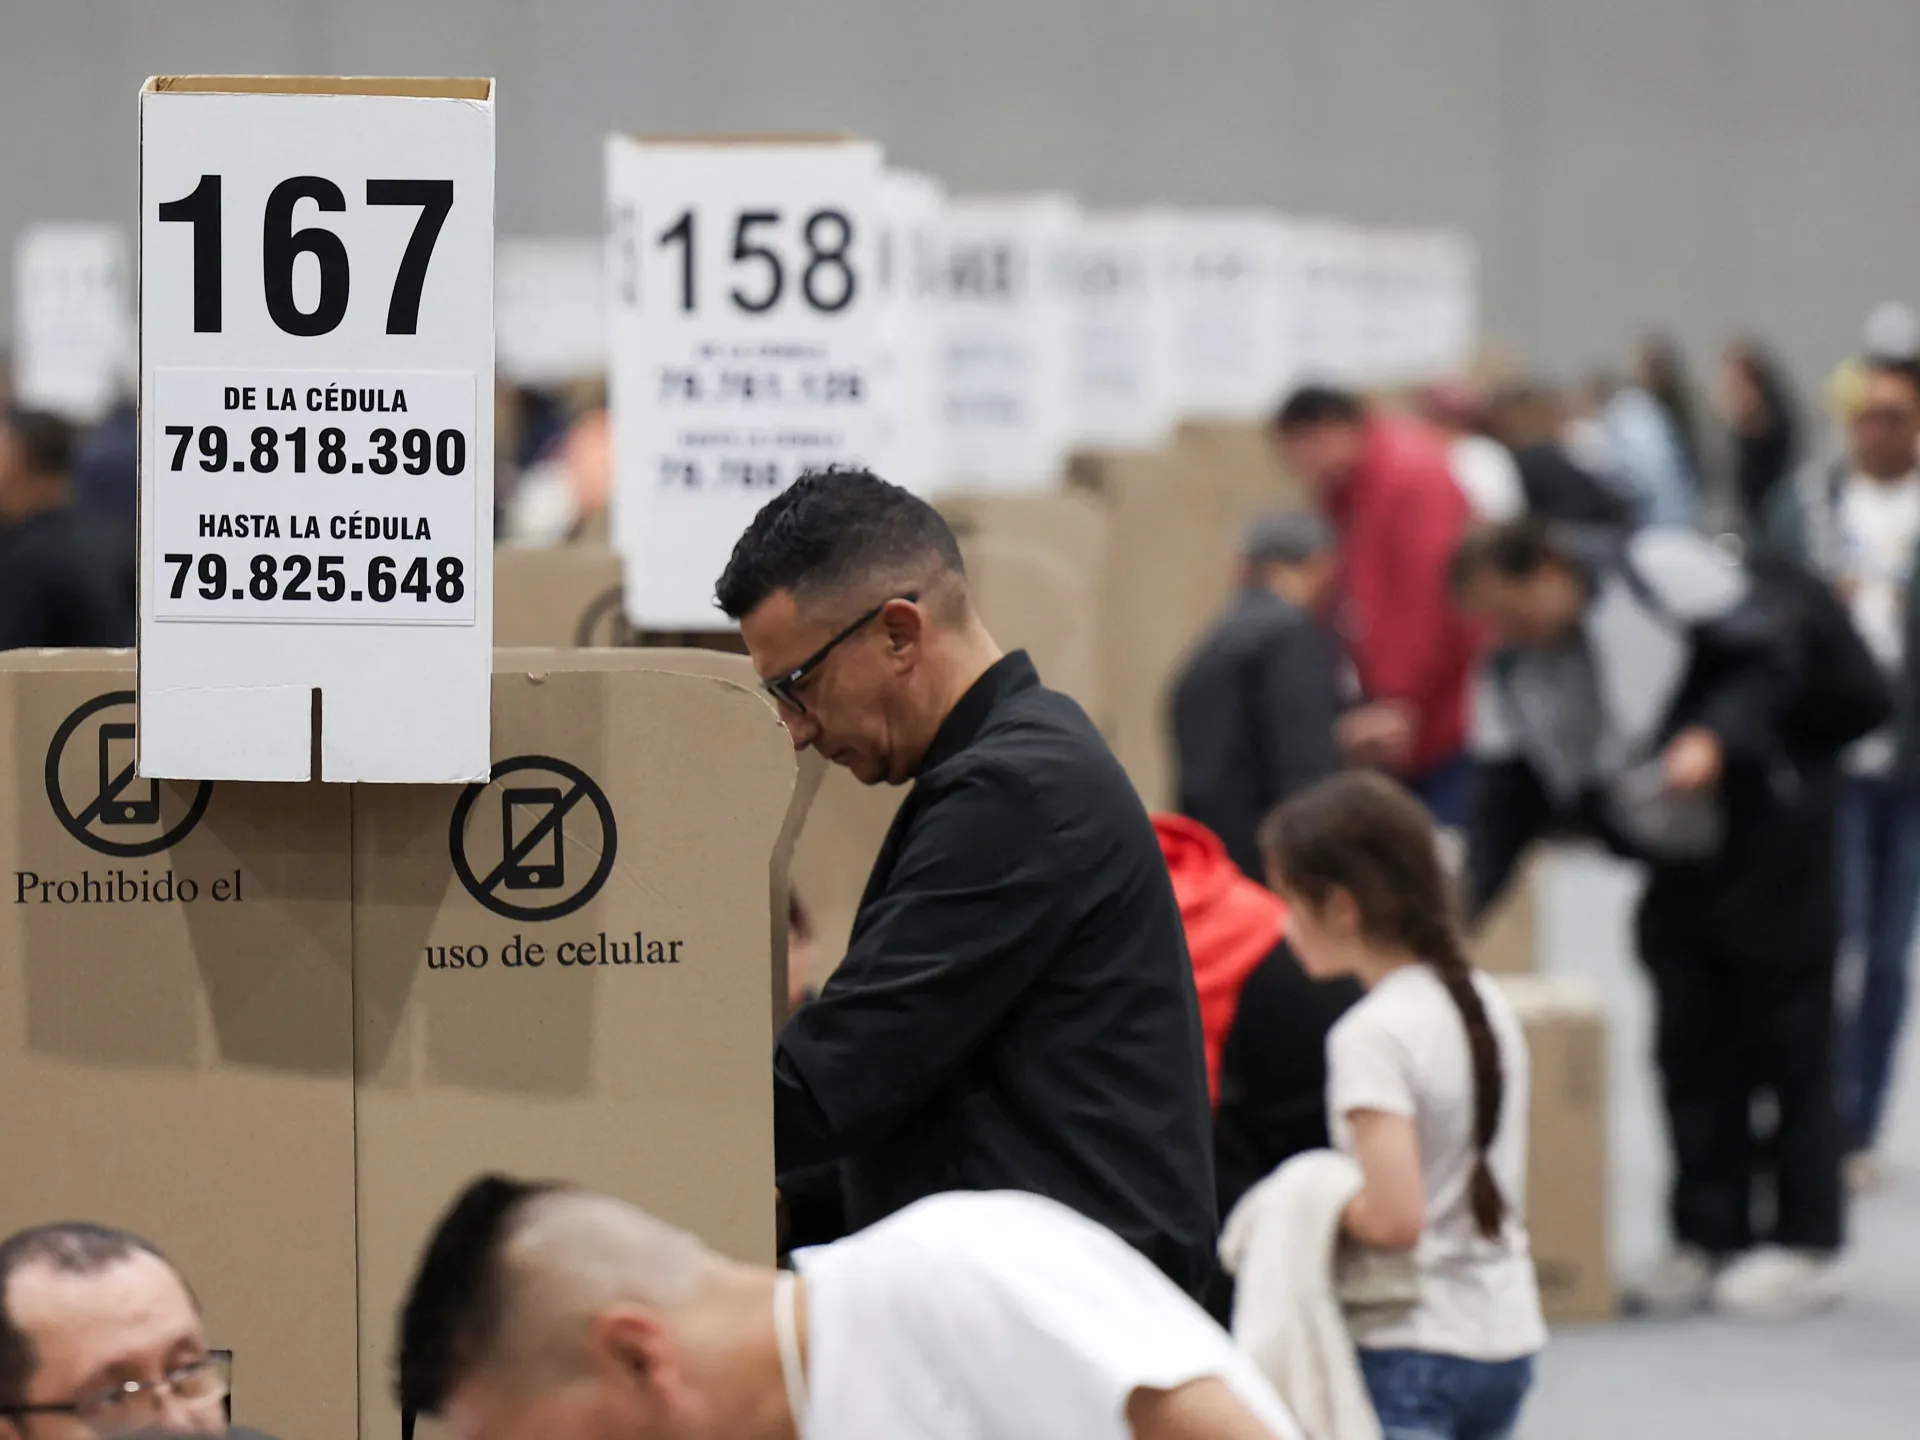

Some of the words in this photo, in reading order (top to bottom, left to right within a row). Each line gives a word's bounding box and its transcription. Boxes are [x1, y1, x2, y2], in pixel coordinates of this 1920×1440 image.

[158, 174, 454, 337] 167
[658, 208, 857, 315] 158
[224, 386, 256, 411] DE
[266, 387, 297, 411] LA
[306, 382, 408, 413] CÉDULA
[164, 425, 466, 476] 79.818.390
[199, 514, 281, 539] HASTA
[290, 515, 321, 539] LA
[330, 510, 432, 541] CÉDULA
[164, 553, 465, 604] 79.825.648
[15, 869, 200, 905] Prohibido
[211, 868, 245, 903] el
[424, 945, 490, 970] uso
[500, 934, 547, 968] de
[556, 931, 684, 967] celular
